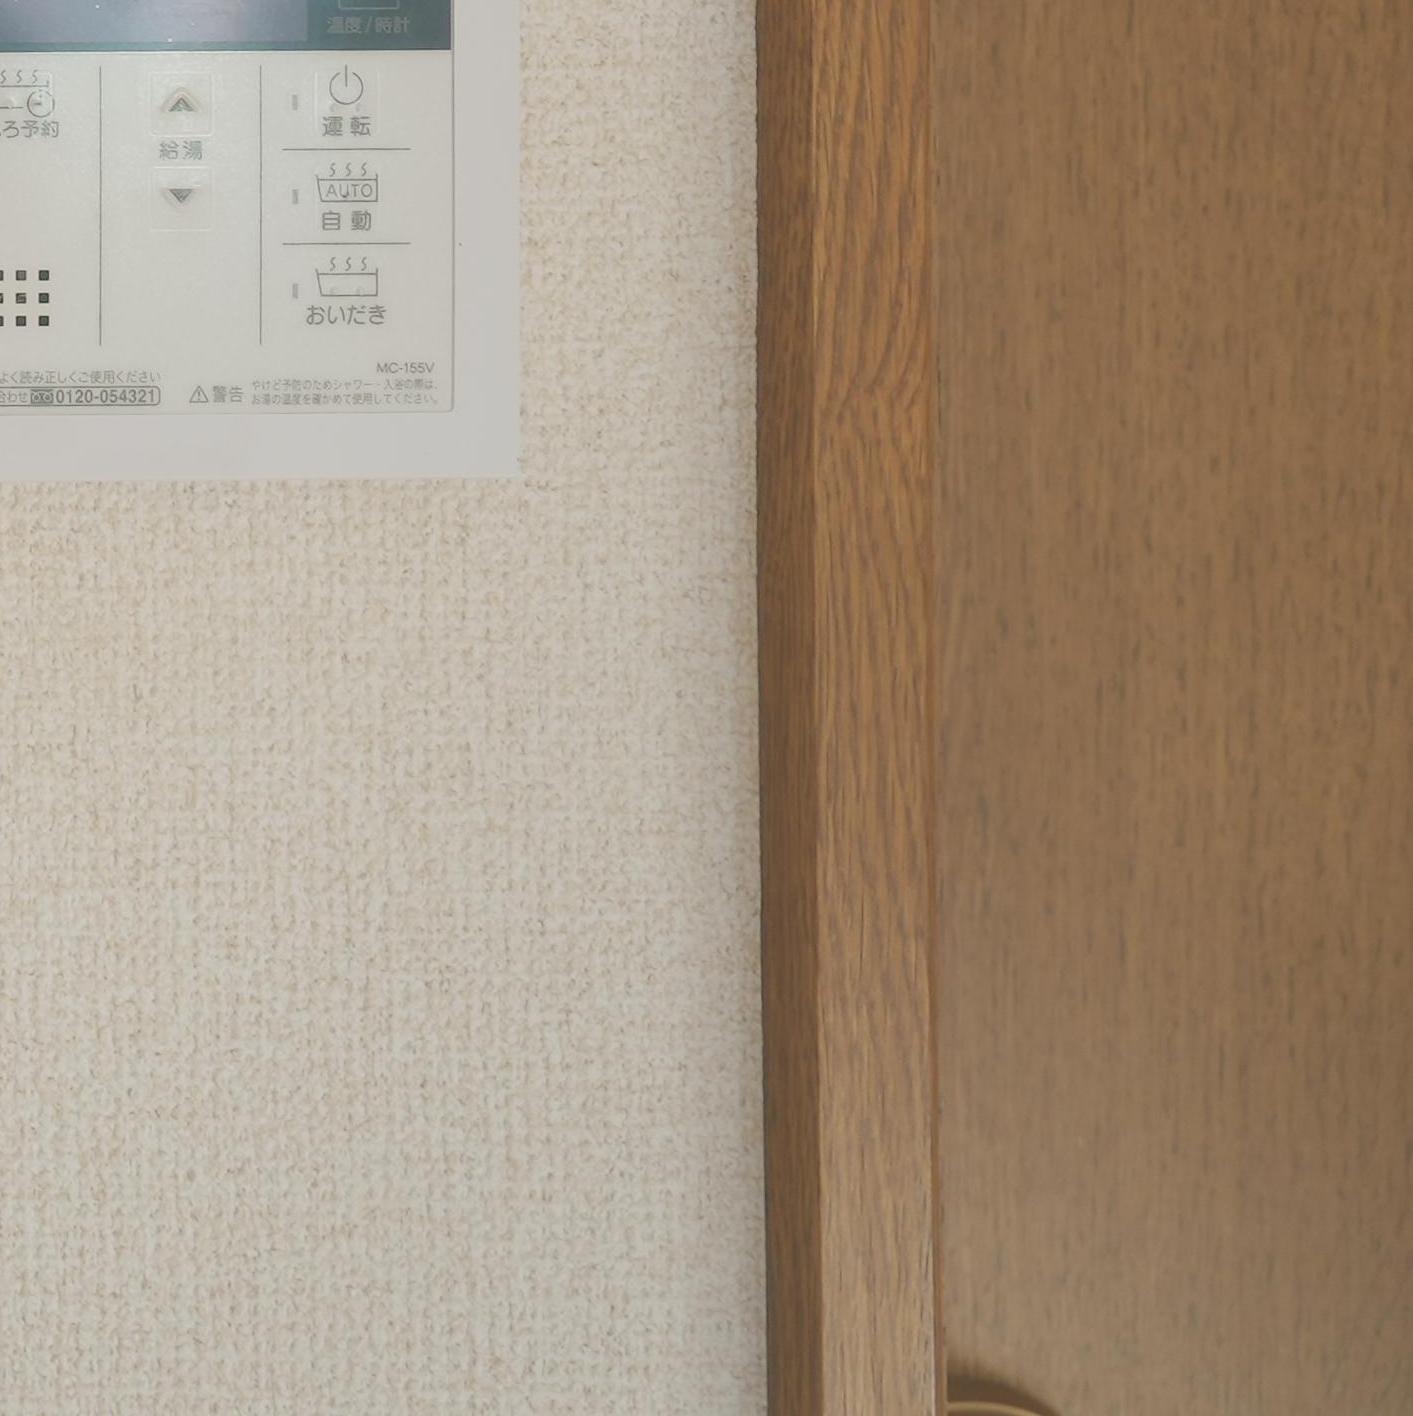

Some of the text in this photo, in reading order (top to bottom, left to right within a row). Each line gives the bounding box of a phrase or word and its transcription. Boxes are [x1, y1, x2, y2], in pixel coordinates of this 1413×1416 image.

[323, 116, 371, 136] 運転
[159, 141, 203, 160] 給湯
[326, 184, 373, 198] AUTO
[323, 210, 372, 231] 自動
[306, 305, 386, 325] おいだき
[376, 362, 434, 373] MC-155V
[56, 389, 156, 403] 0120-054321
[212, 385, 244, 403] 警告
